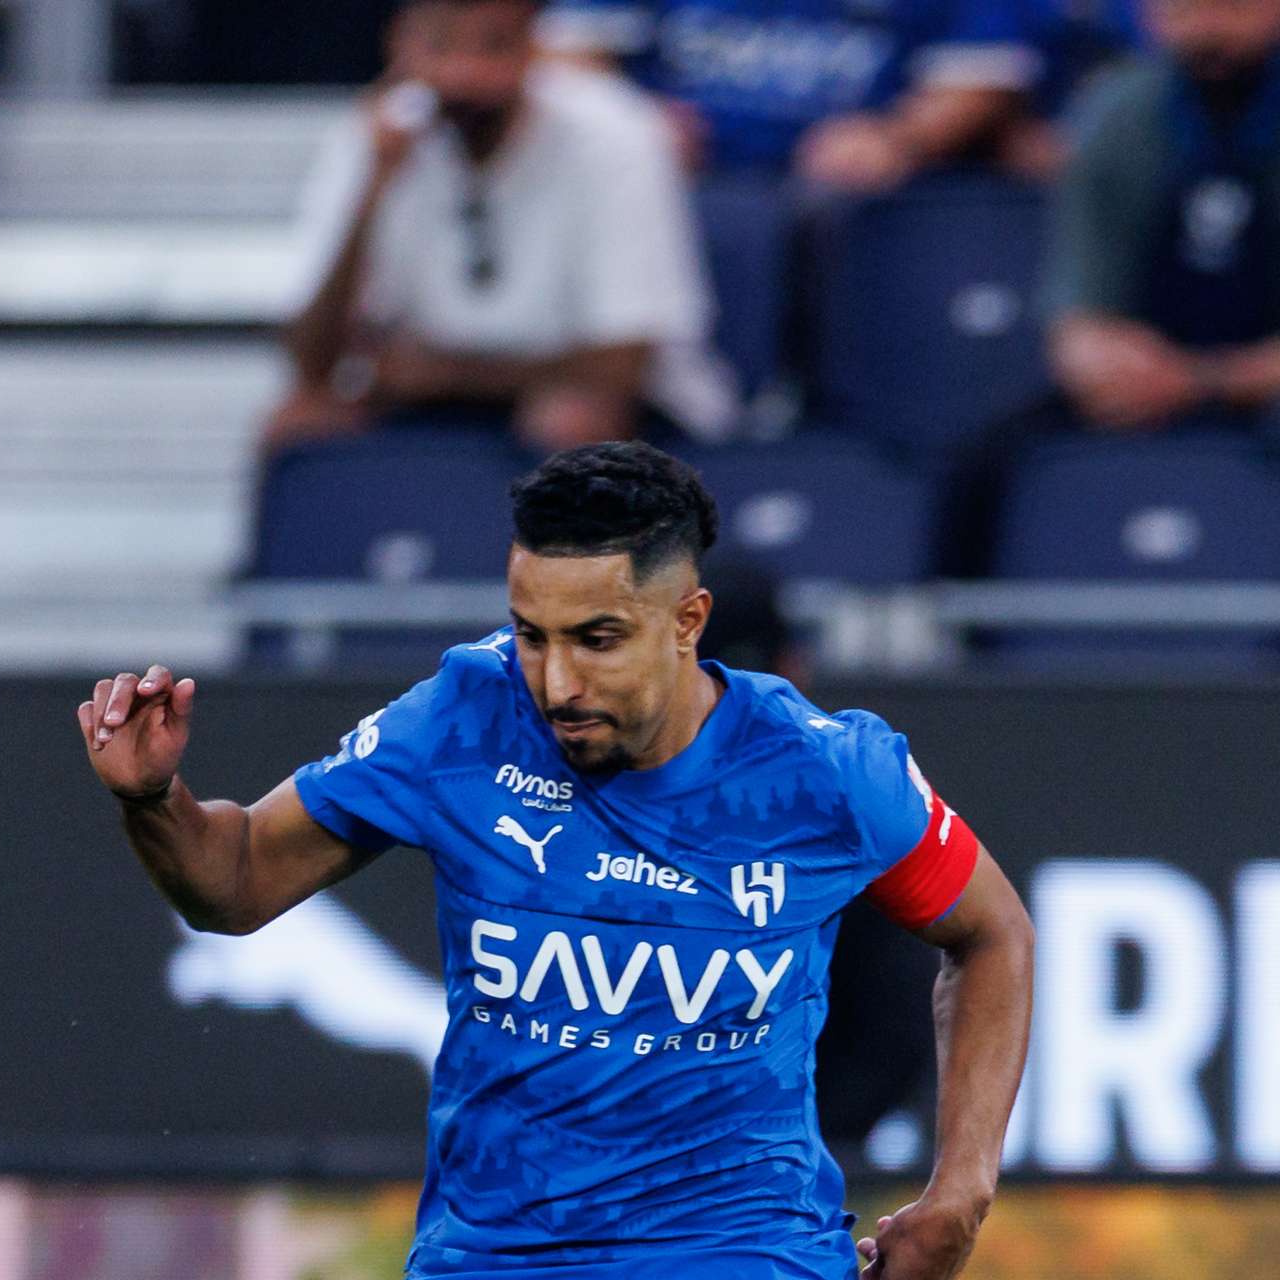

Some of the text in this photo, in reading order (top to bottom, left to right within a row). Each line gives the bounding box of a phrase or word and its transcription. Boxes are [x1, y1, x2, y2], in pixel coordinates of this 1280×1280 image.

[494, 763, 574, 800] flynas
[471, 918, 794, 1024] SAVVY
[472, 1005, 772, 1056] GAMES GROUP
